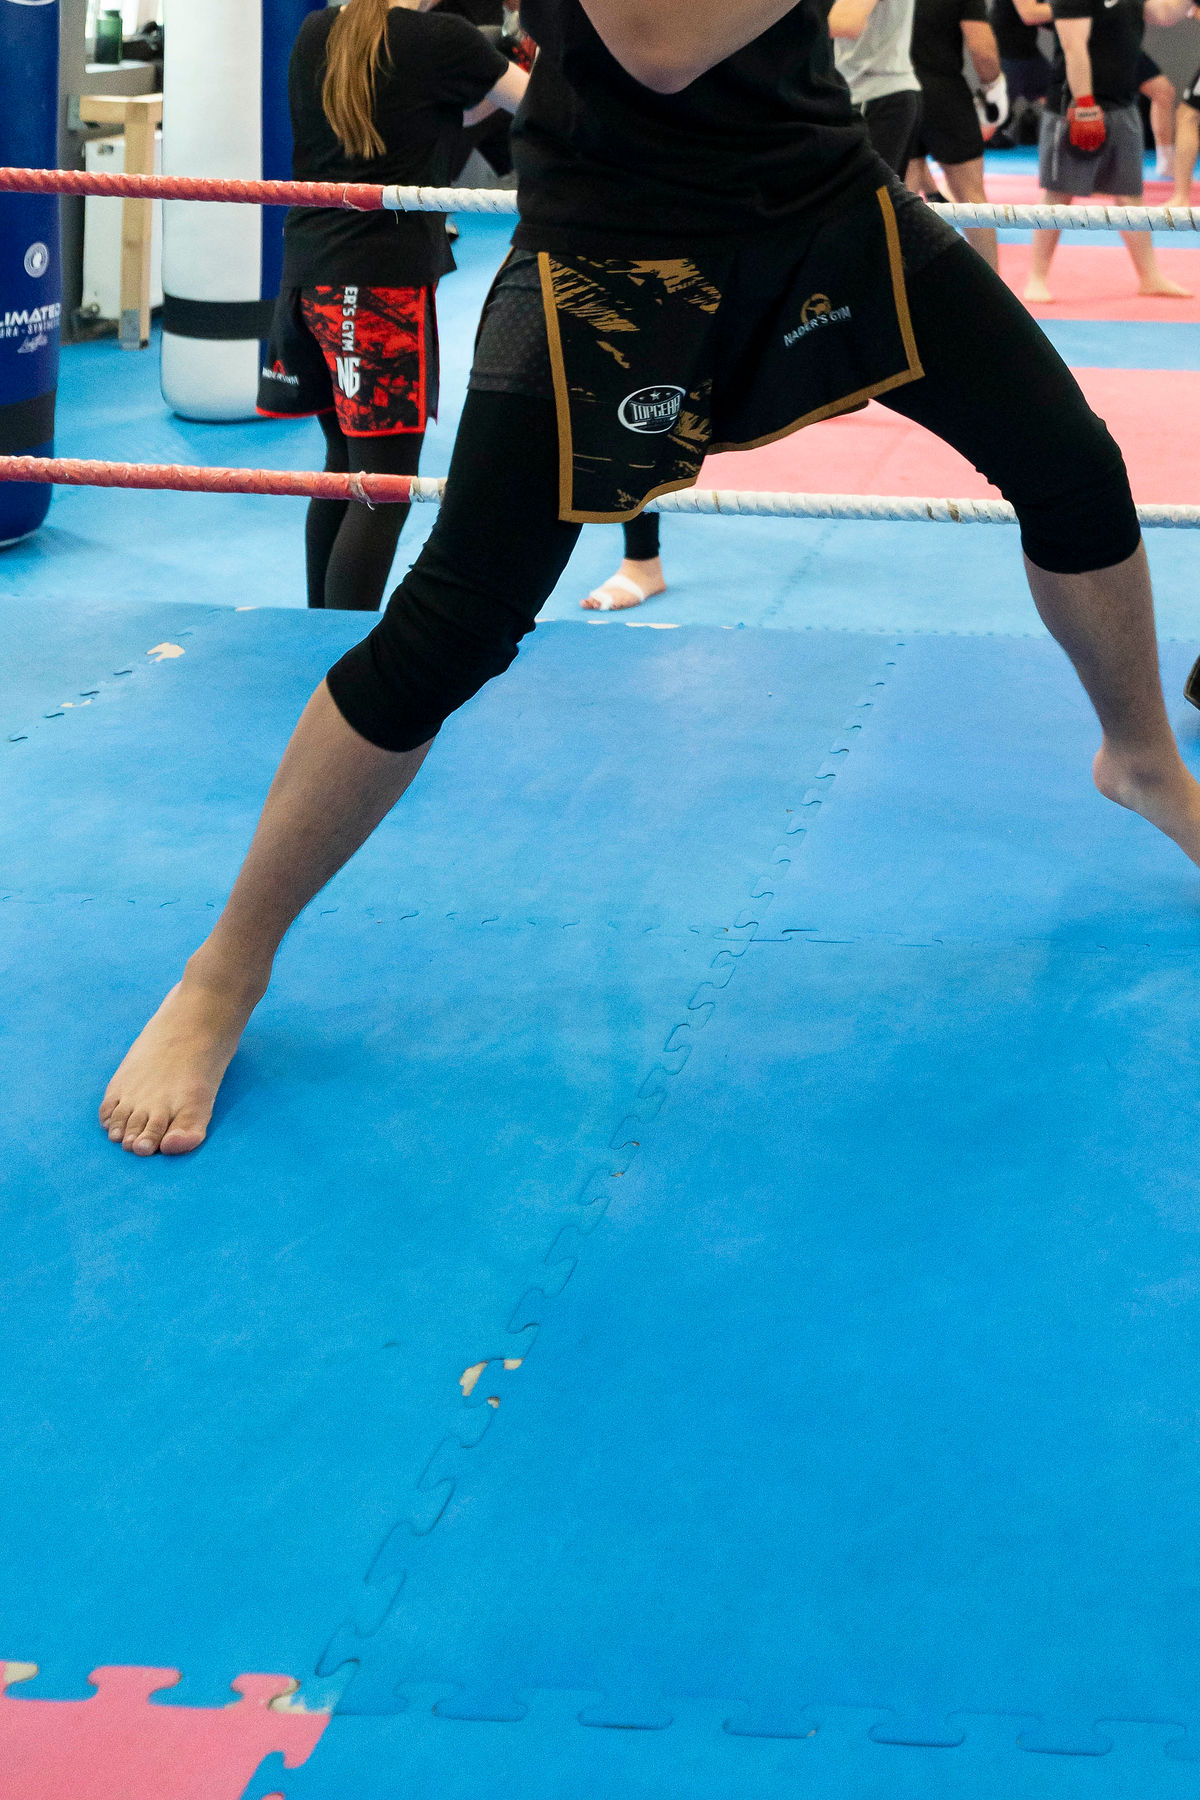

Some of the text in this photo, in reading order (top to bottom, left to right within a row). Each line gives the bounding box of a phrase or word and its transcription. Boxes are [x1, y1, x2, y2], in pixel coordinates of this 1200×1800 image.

[341, 320, 356, 352] GYM
[784, 305, 852, 347] NADER'S GYM
[630, 394, 681, 421] TOPGEAR
